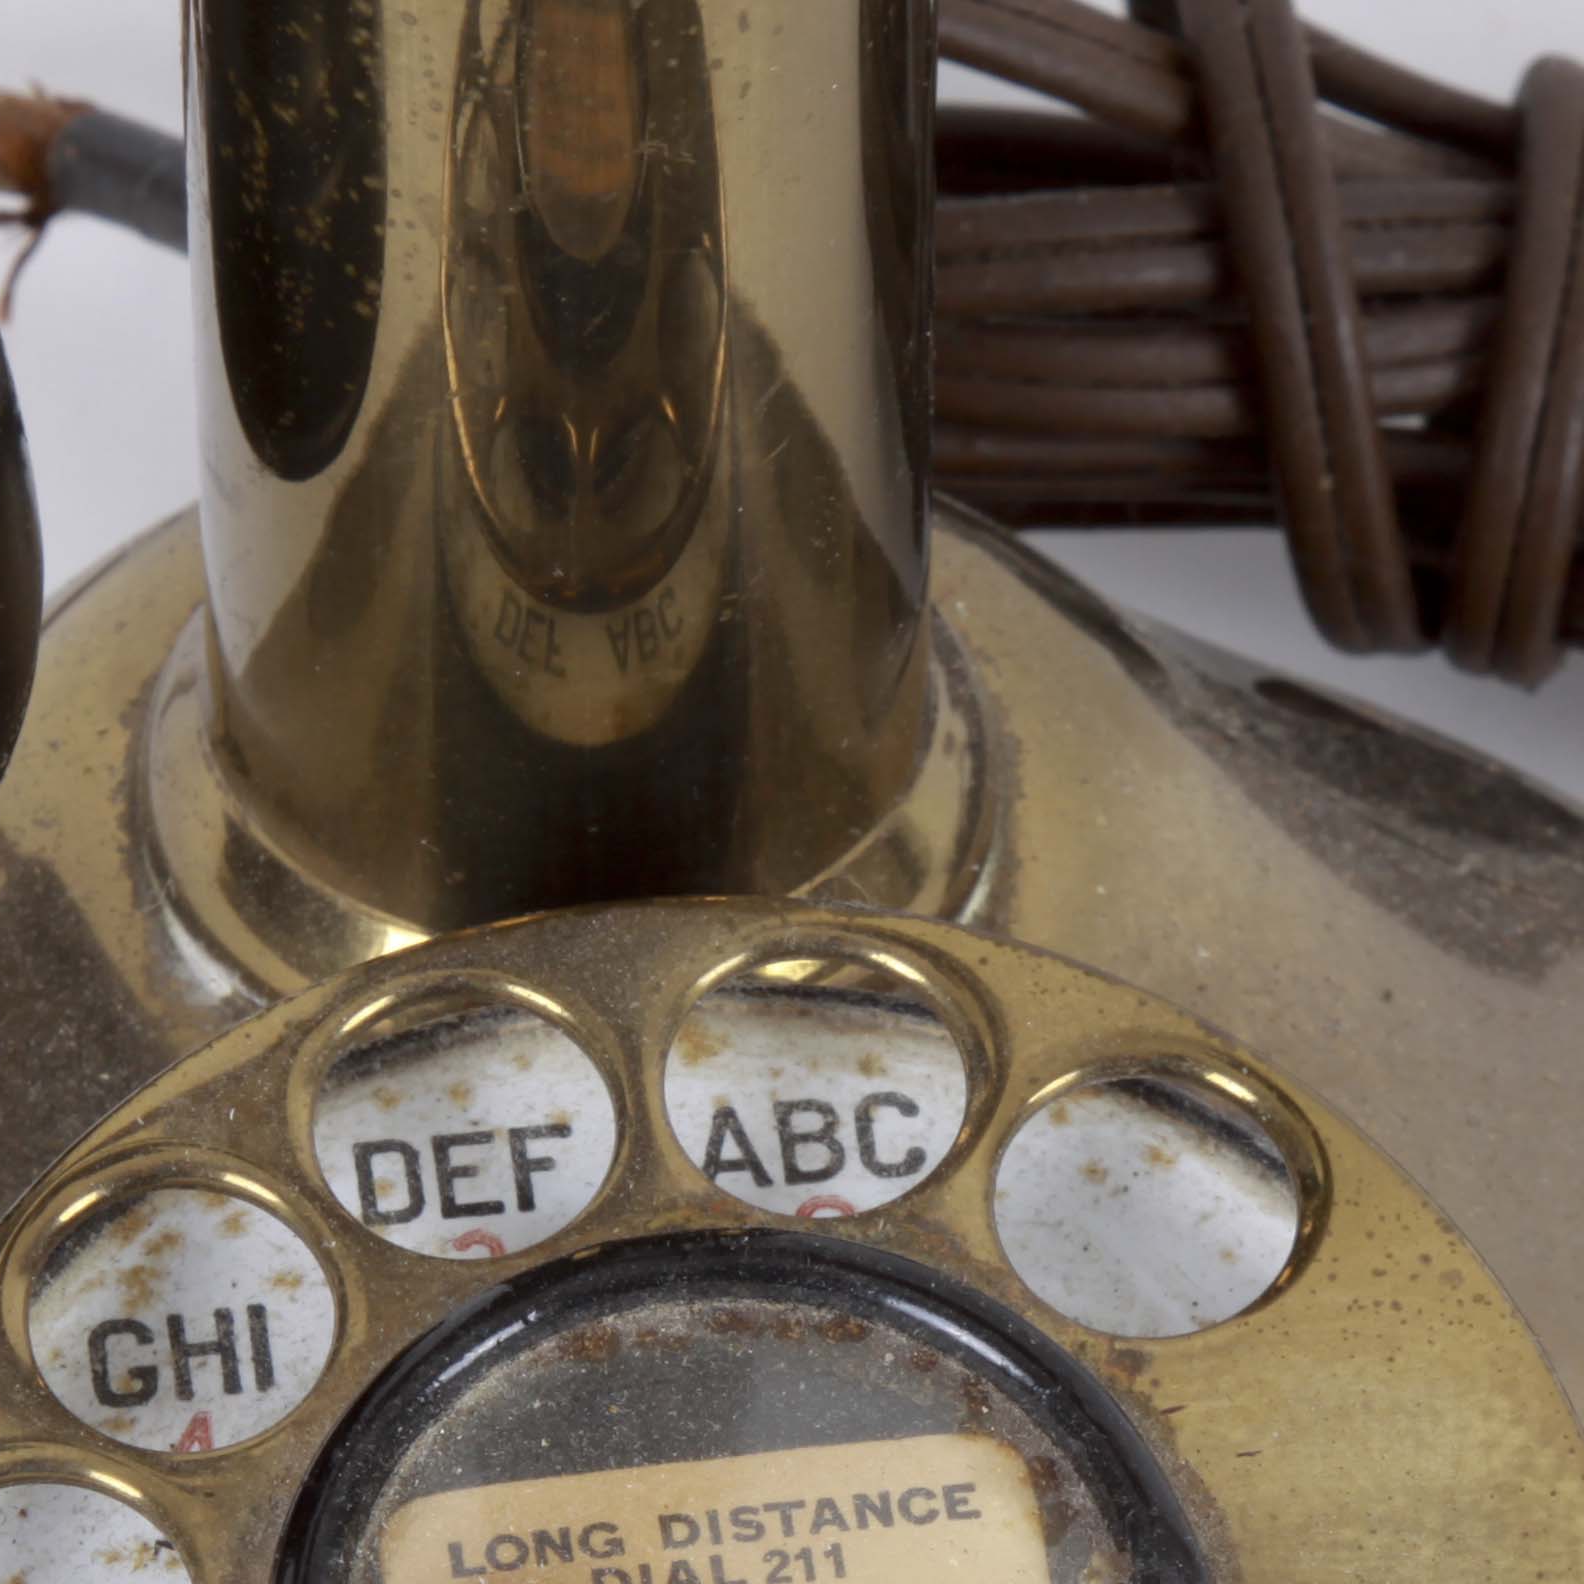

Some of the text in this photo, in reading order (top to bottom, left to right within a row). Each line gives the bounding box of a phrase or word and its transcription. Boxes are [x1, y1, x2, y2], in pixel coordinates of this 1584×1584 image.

[352, 1122, 572, 1227] DEF
[701, 1091, 927, 1188] ABC
[87, 1302, 275, 1408] GHI
[448, 1482, 982, 1579] LONG DISTANCE
